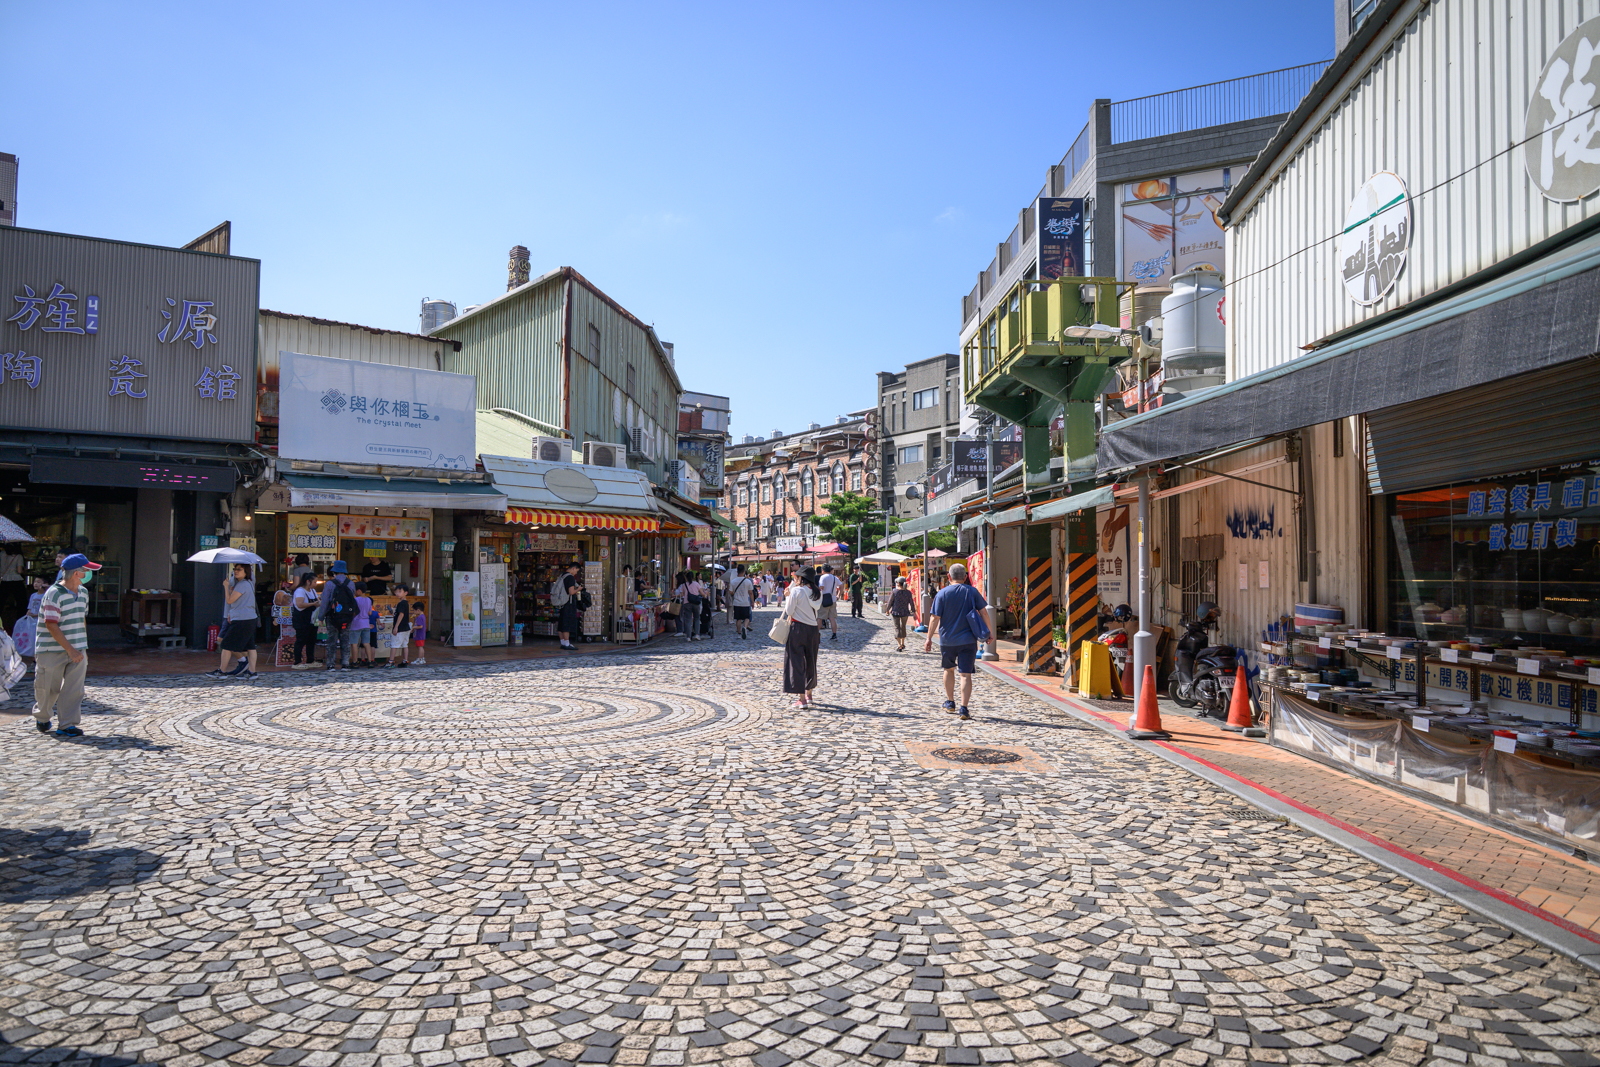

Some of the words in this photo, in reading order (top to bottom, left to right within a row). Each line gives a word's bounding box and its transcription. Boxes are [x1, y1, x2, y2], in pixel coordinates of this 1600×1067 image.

[356, 416, 372, 425] The
[374, 418, 402, 428] Crystal
[404, 421, 422, 429] Meet
[1467, 481, 1552, 517] 陶瓷餐具
[1488, 518, 1578, 551] 歡迎訂製
